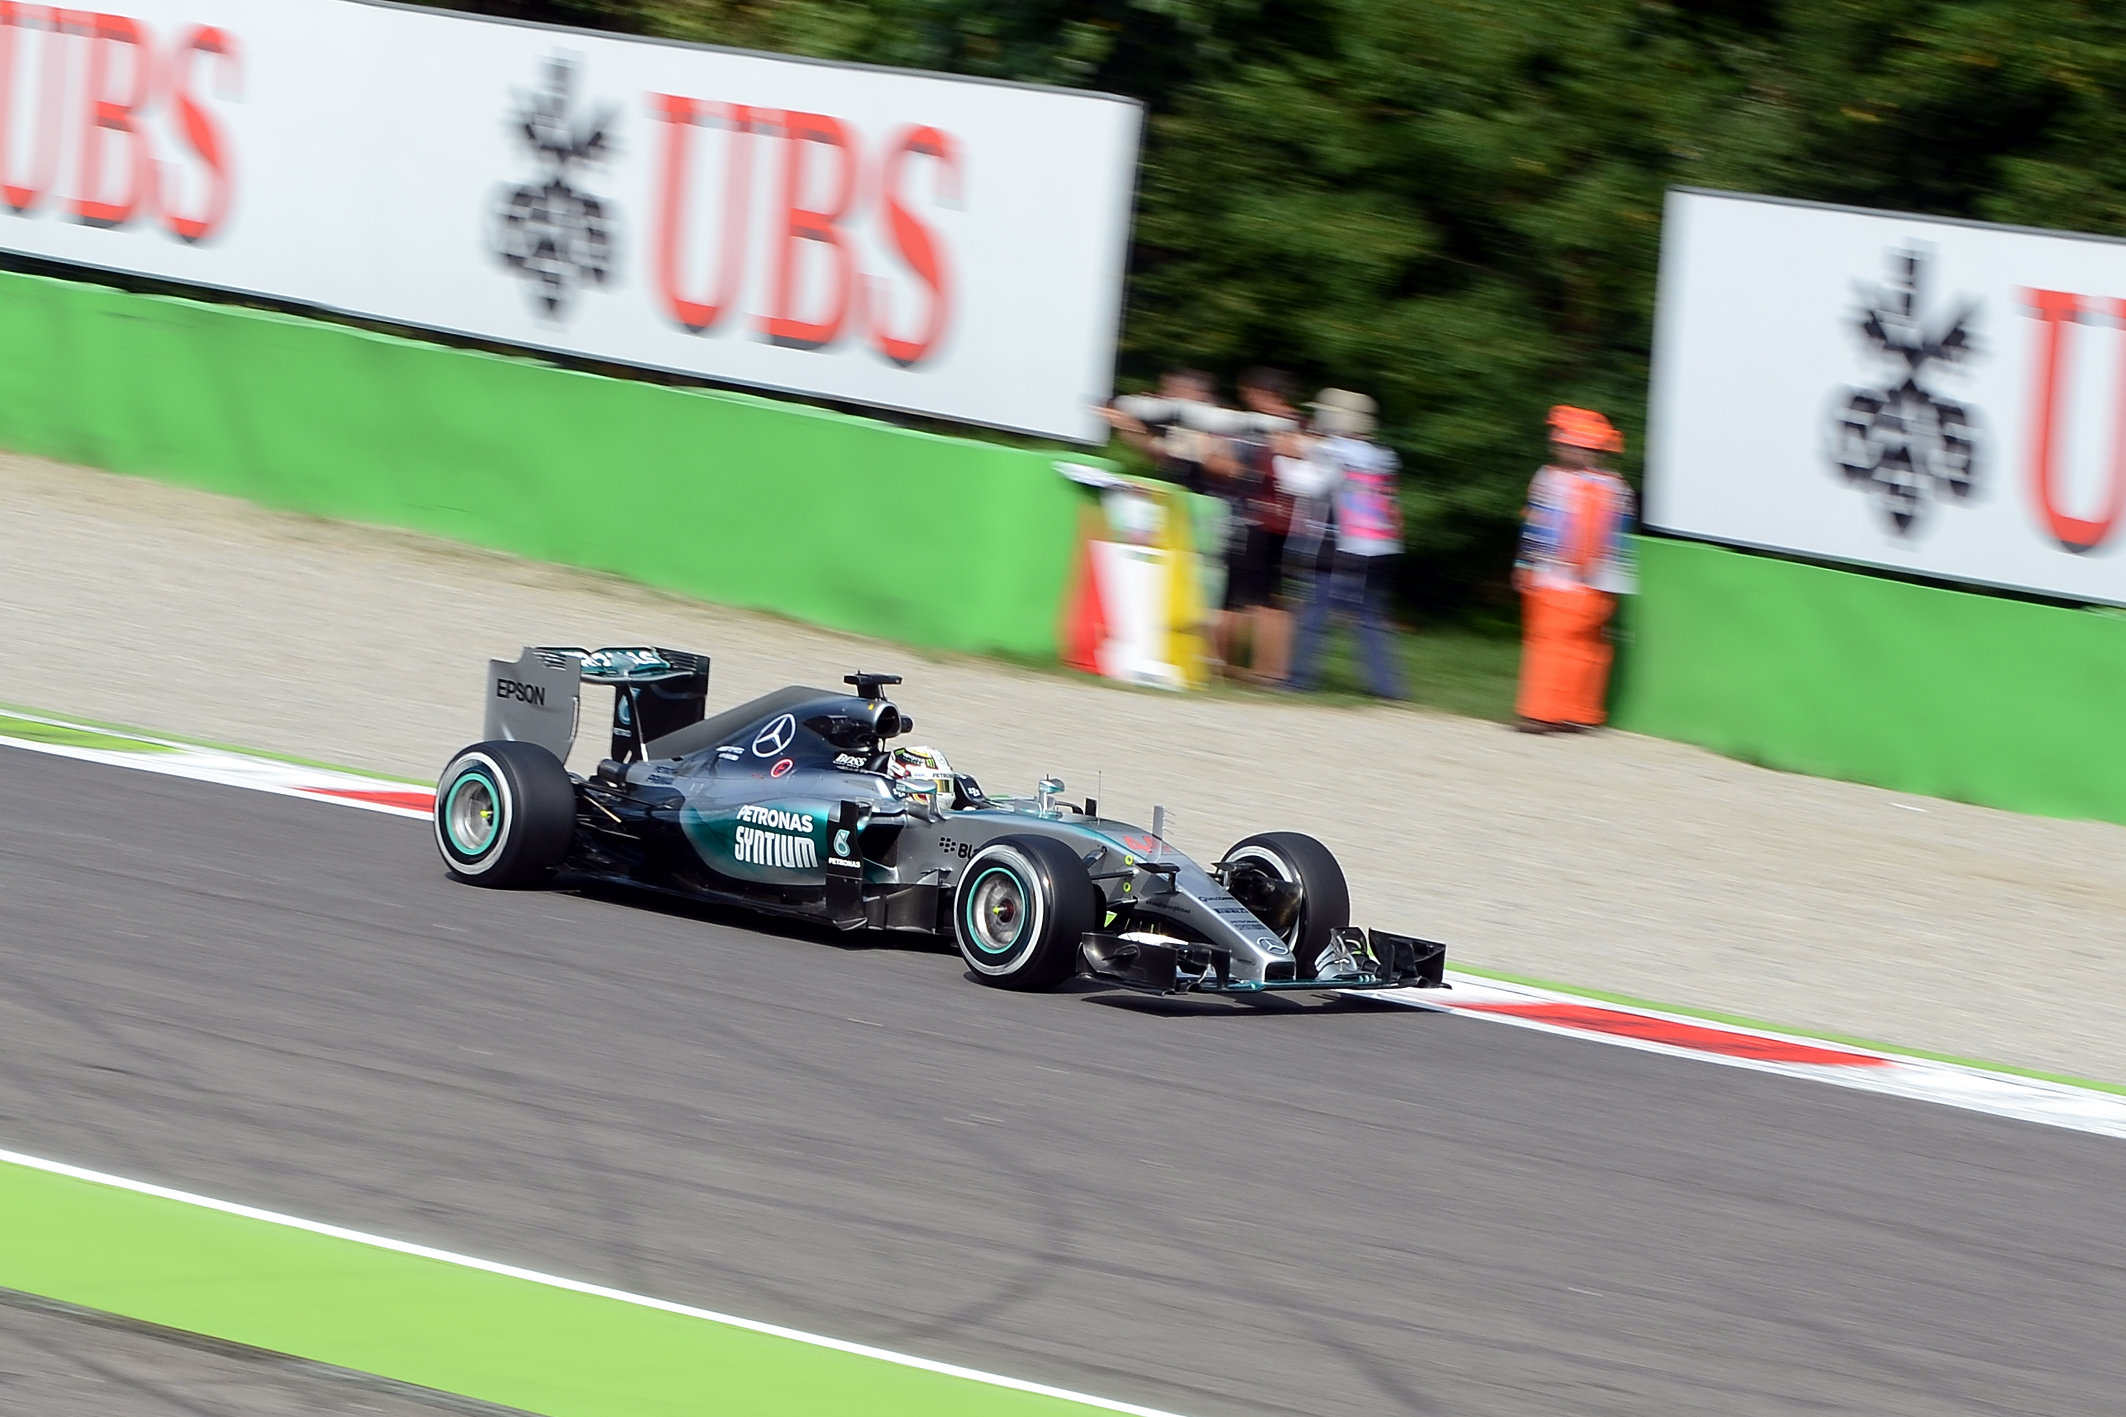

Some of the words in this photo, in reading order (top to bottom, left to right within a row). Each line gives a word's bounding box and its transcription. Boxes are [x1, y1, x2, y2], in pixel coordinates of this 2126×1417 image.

[0, 1, 248, 246] UBS
[640, 90, 968, 370] UBS
[497, 678, 545, 706] EPSON
[836, 753, 867, 766] BOSS
[736, 805, 813, 833] PETRONAS
[734, 826, 818, 868] SYNTIUM
[828, 857, 861, 868] PETRONAS
